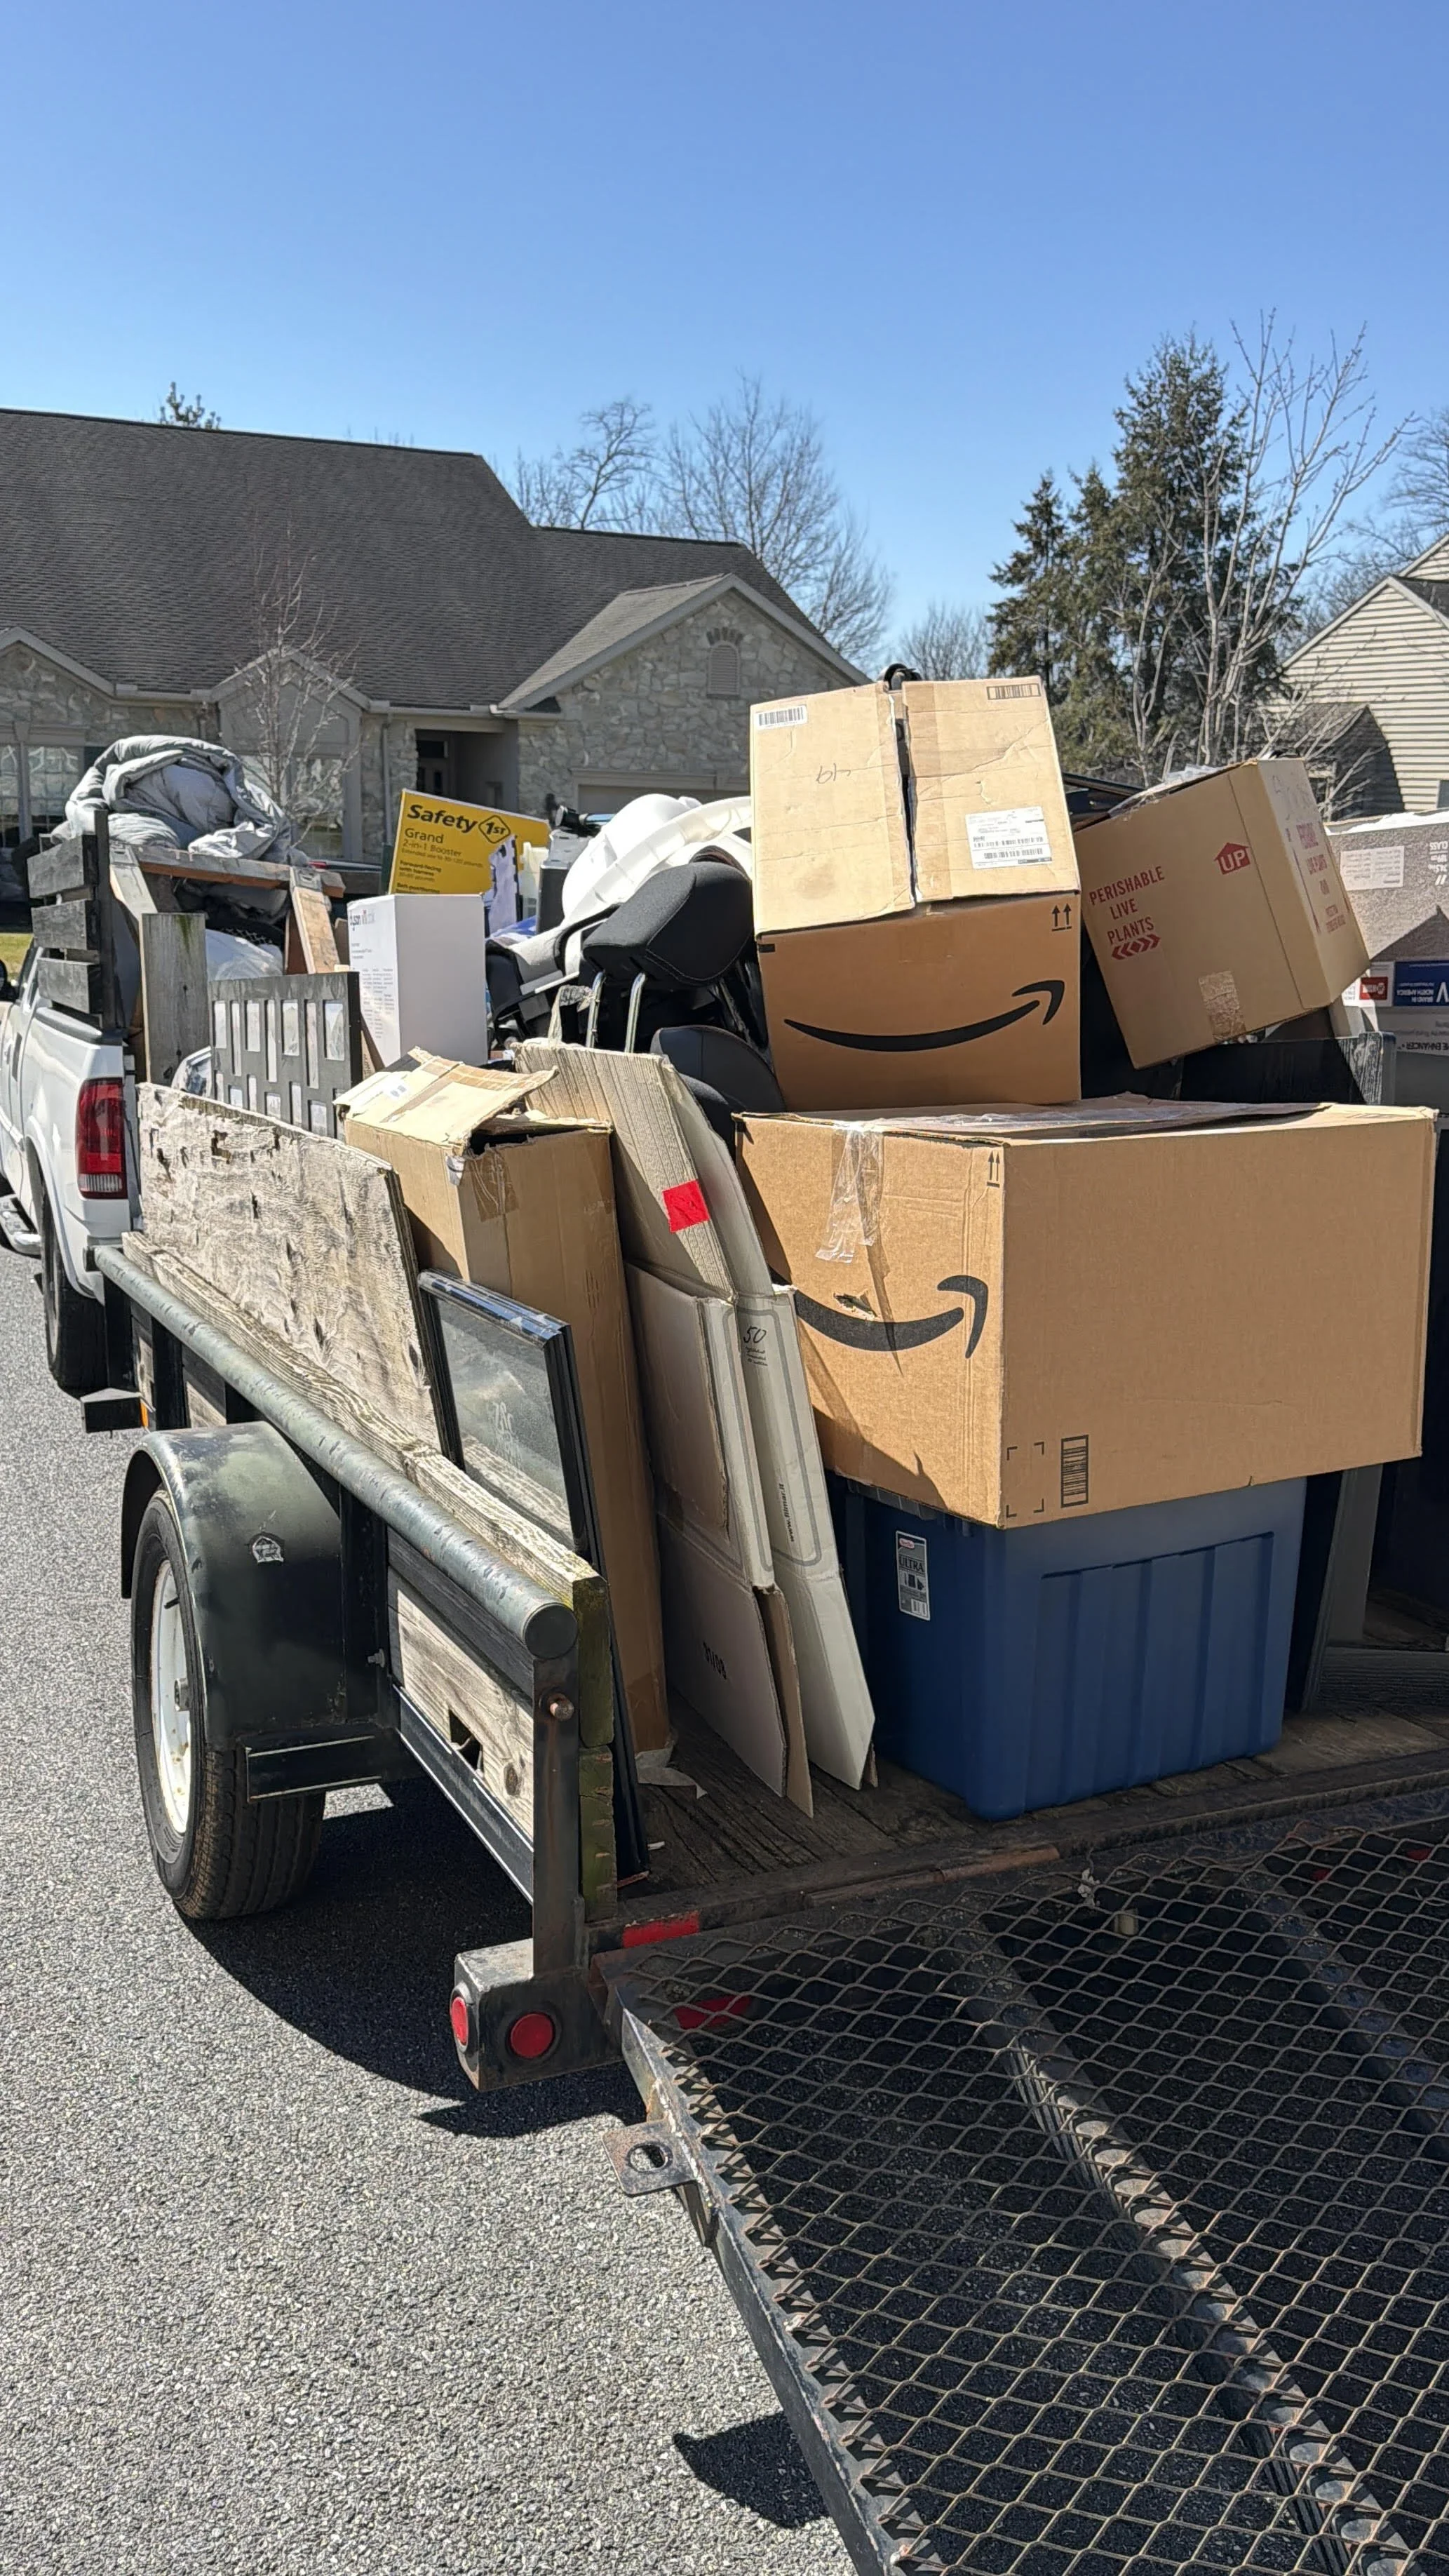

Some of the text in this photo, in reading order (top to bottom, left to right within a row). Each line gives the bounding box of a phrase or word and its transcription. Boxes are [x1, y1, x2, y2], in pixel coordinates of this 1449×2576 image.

[407, 804, 478, 833] Safety
[405, 827, 444, 844] Grand
[403, 839, 462, 857] 2-in-1 Booster
[1429, 841, 1448, 851] CLASS
[400, 859, 442, 873] Forward-facing
[1220, 850, 1246, 871] UP
[1089, 866, 1165, 906] PERISHABLE
[1110, 898, 1138, 920] LIVE
[1107, 916, 1154, 945] PLANTS
[1406, 1041, 1441, 1051] ENHANCER
[743, 1325, 767, 1343] 50
[779, 1483, 794, 1542] www.filmar.it
[898, 1555, 924, 1573] ULTRA
